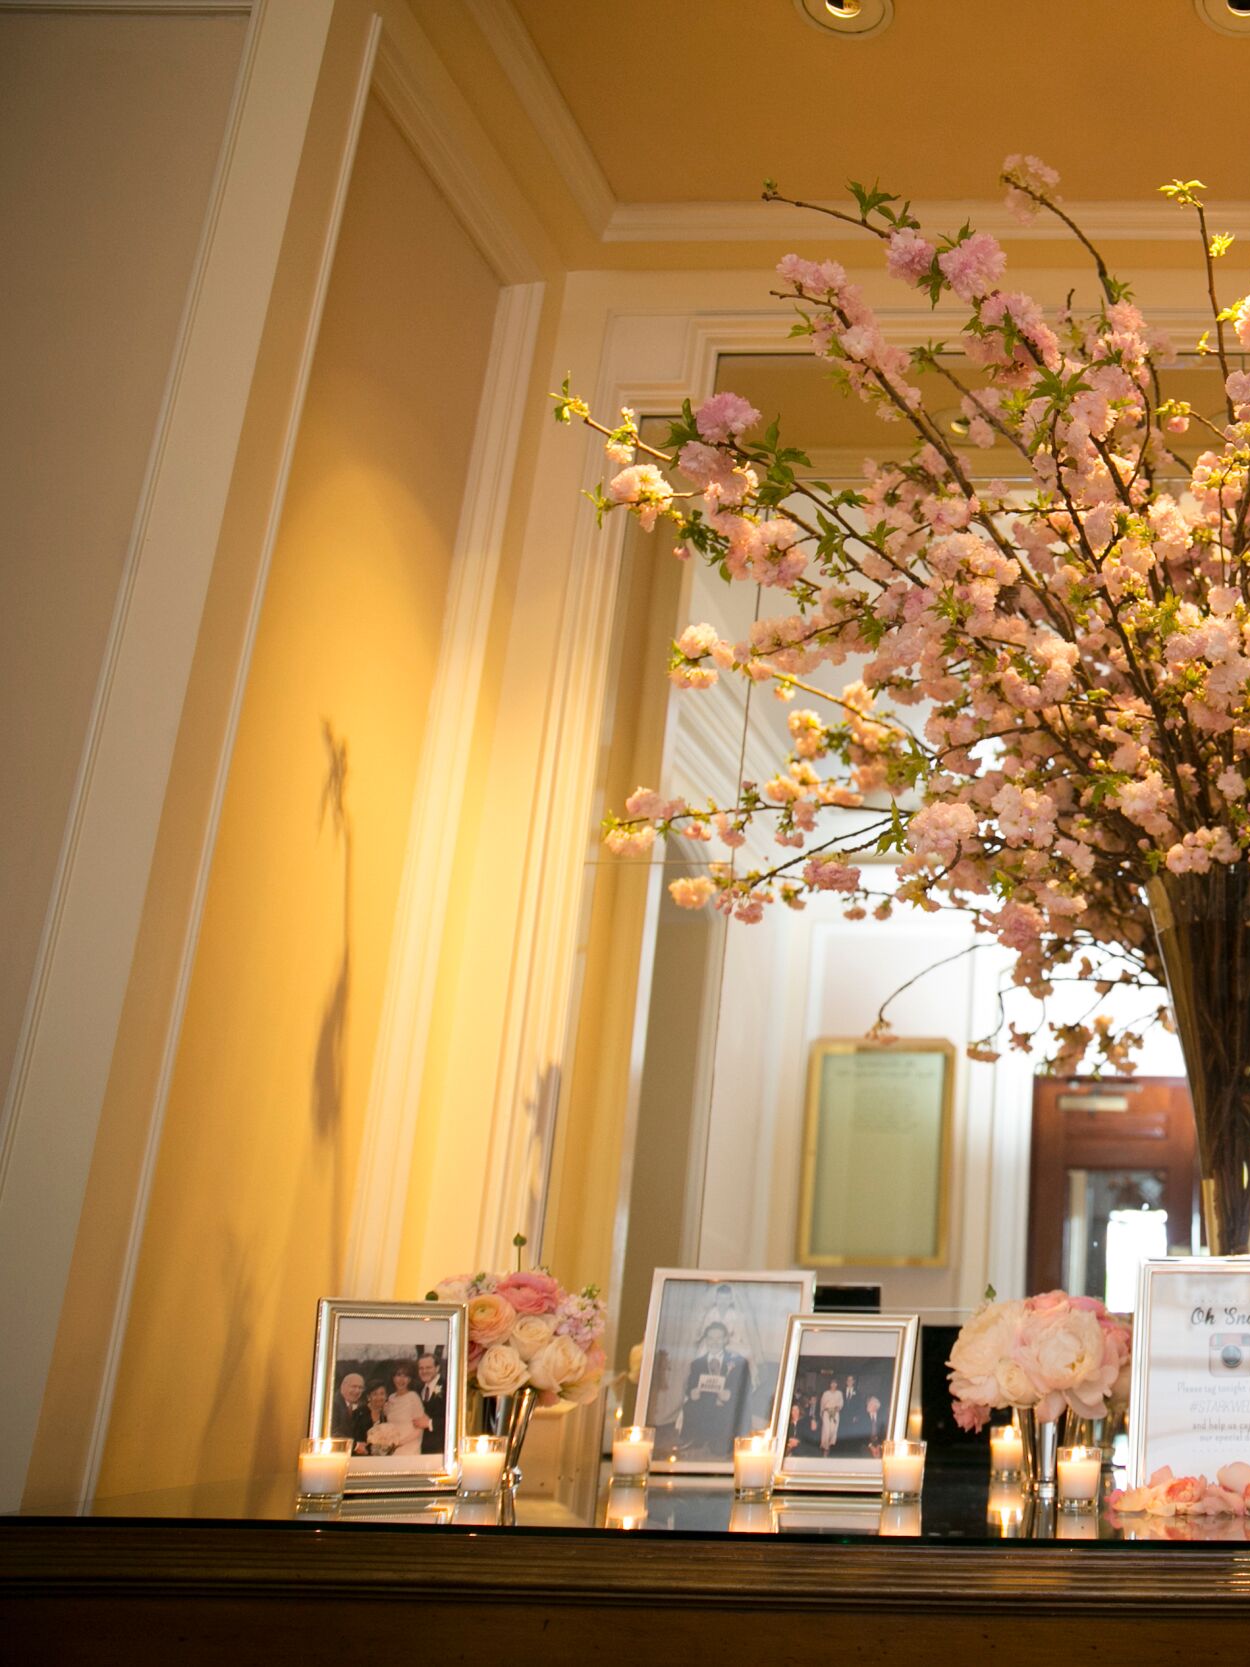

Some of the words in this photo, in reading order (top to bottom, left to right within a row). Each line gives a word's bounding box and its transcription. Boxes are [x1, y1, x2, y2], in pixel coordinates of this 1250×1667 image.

[1191, 1306, 1215, 1325] Oh
[1192, 1418, 1206, 1430] and
[1208, 1418, 1225, 1432] help
